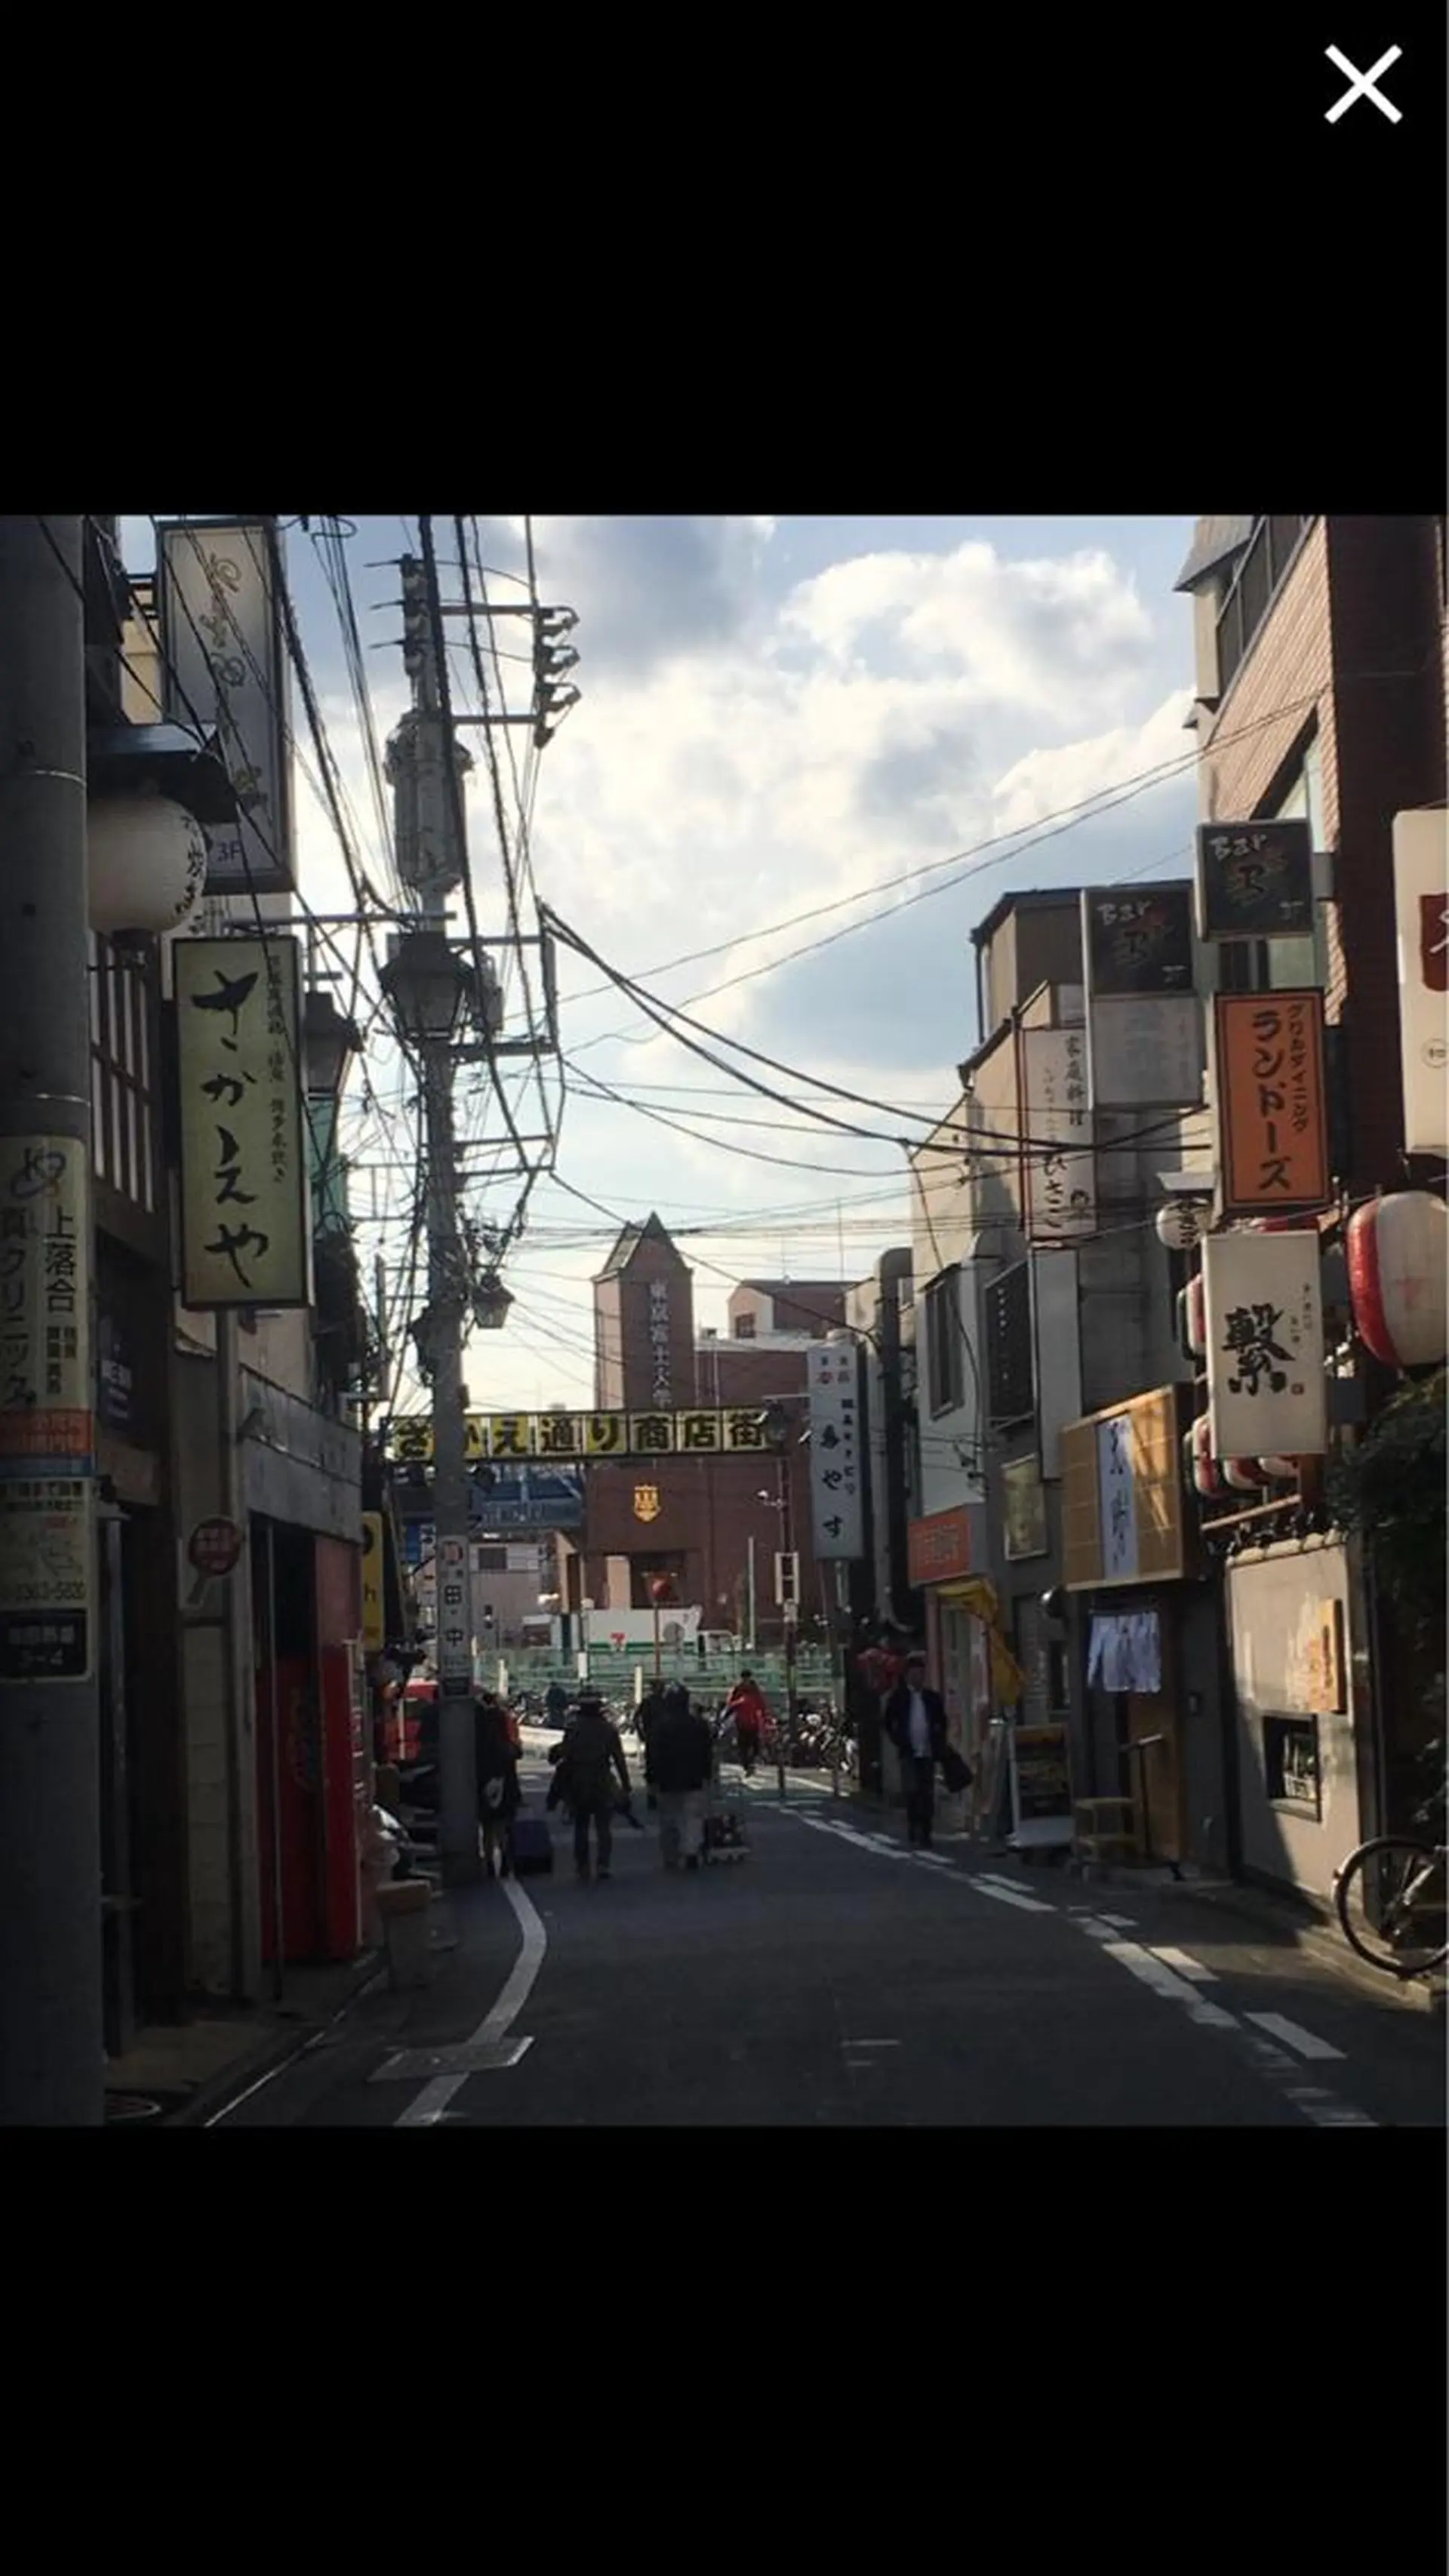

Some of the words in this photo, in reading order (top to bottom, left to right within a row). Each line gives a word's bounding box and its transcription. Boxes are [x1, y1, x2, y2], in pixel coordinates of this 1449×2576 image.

[1208, 833, 1267, 862] Bar
[1096, 900, 1152, 927] Bar
[191, 969, 269, 1288] さかえや
[45, 1205, 76, 1313] 上落合
[648, 1279, 671, 1408] 東京富士大学
[1221, 1302, 1296, 1396] 繋
